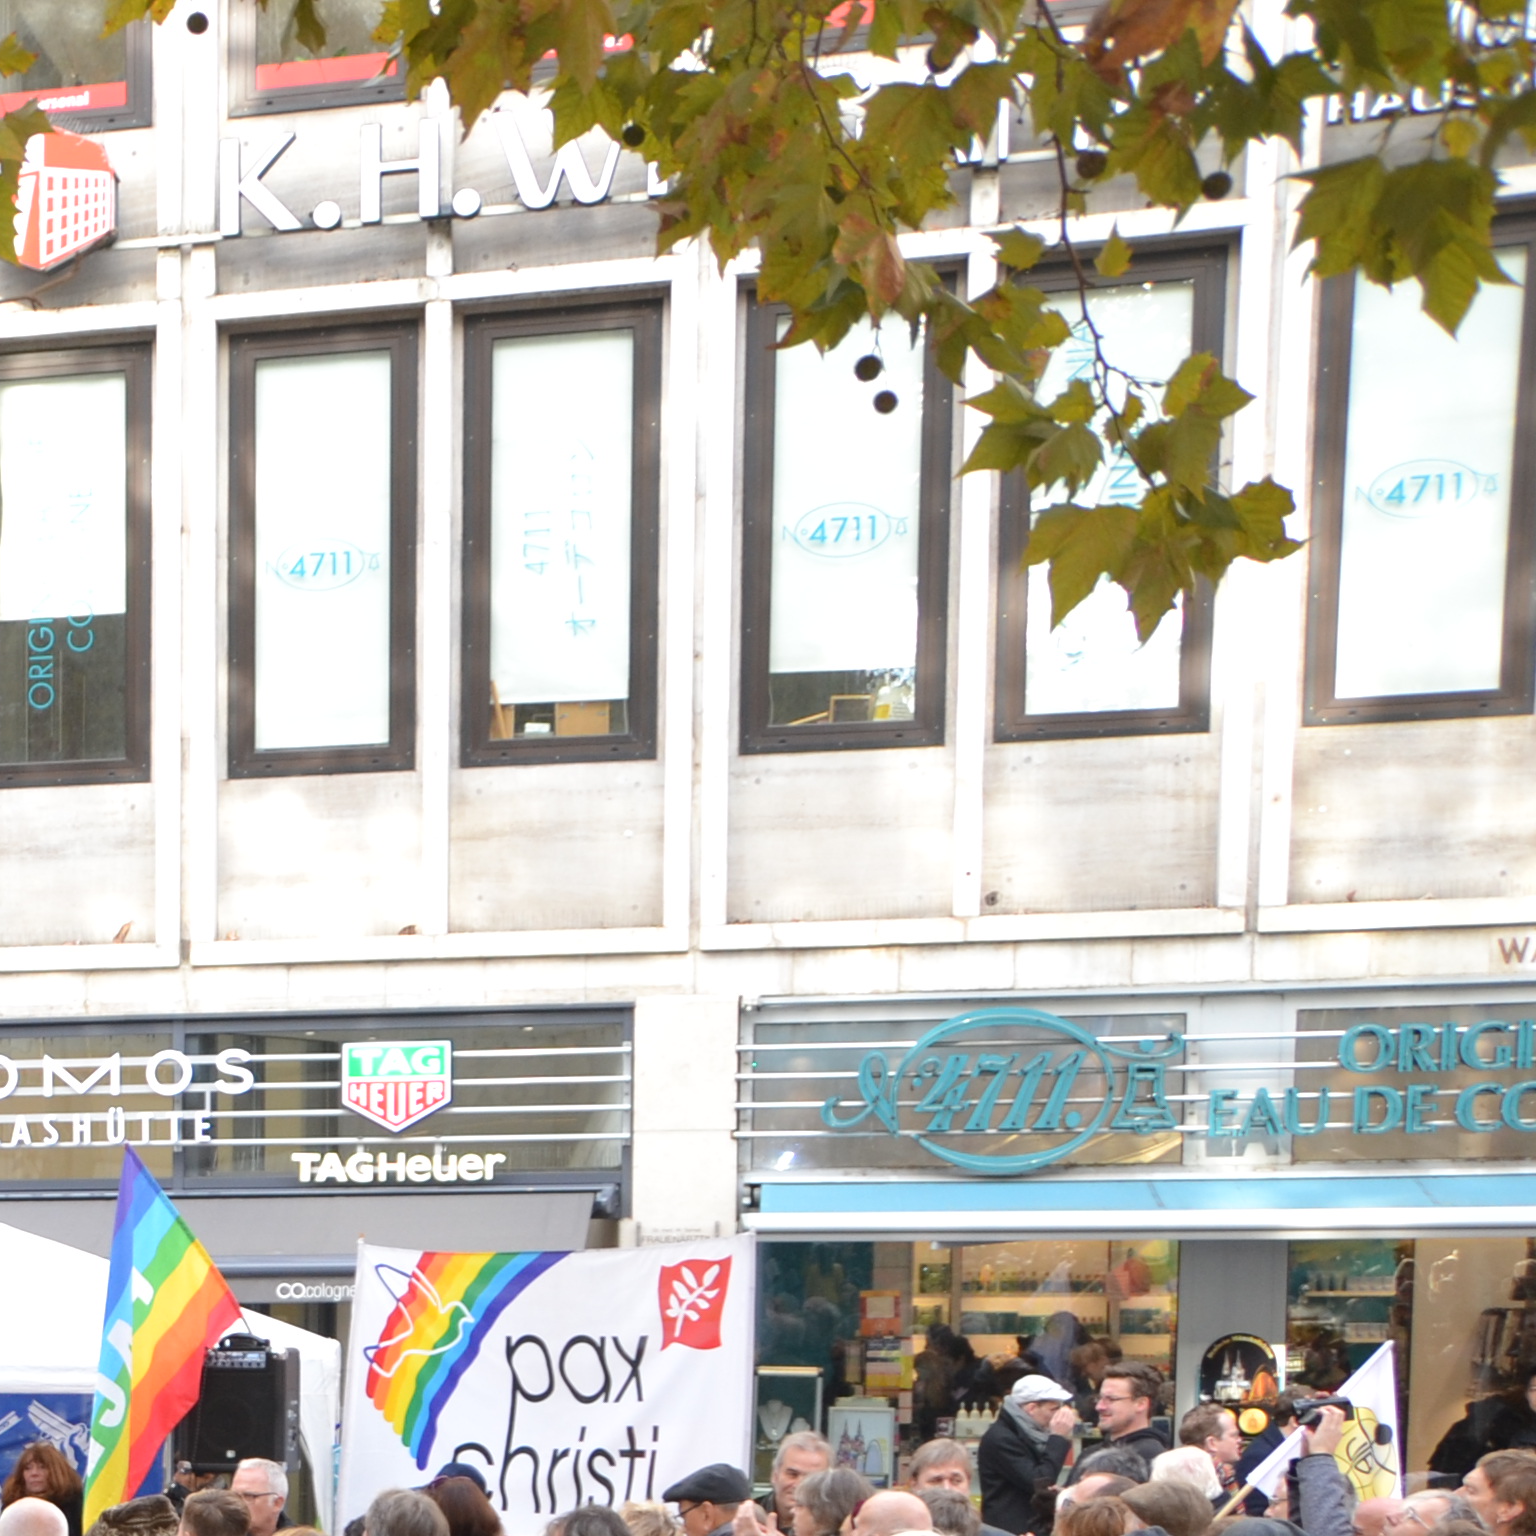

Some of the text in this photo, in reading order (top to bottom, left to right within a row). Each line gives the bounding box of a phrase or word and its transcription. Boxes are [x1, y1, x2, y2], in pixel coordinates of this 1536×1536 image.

[36, 90, 90, 112] ersonal
[1385, 472, 1465, 506] 4711
[808, 511, 878, 544] 4711
[289, 550, 353, 579] 4711
[1497, 937, 1536, 964] W
[351, 1046, 442, 1076] TAG
[1338, 1019, 1536, 1074] ORIGI
[348, 1081, 445, 1125] HEUER
[1208, 1086, 1331, 1137] EAU
[1353, 1084, 1438, 1135] DE
[505, 1334, 649, 1404] pax
